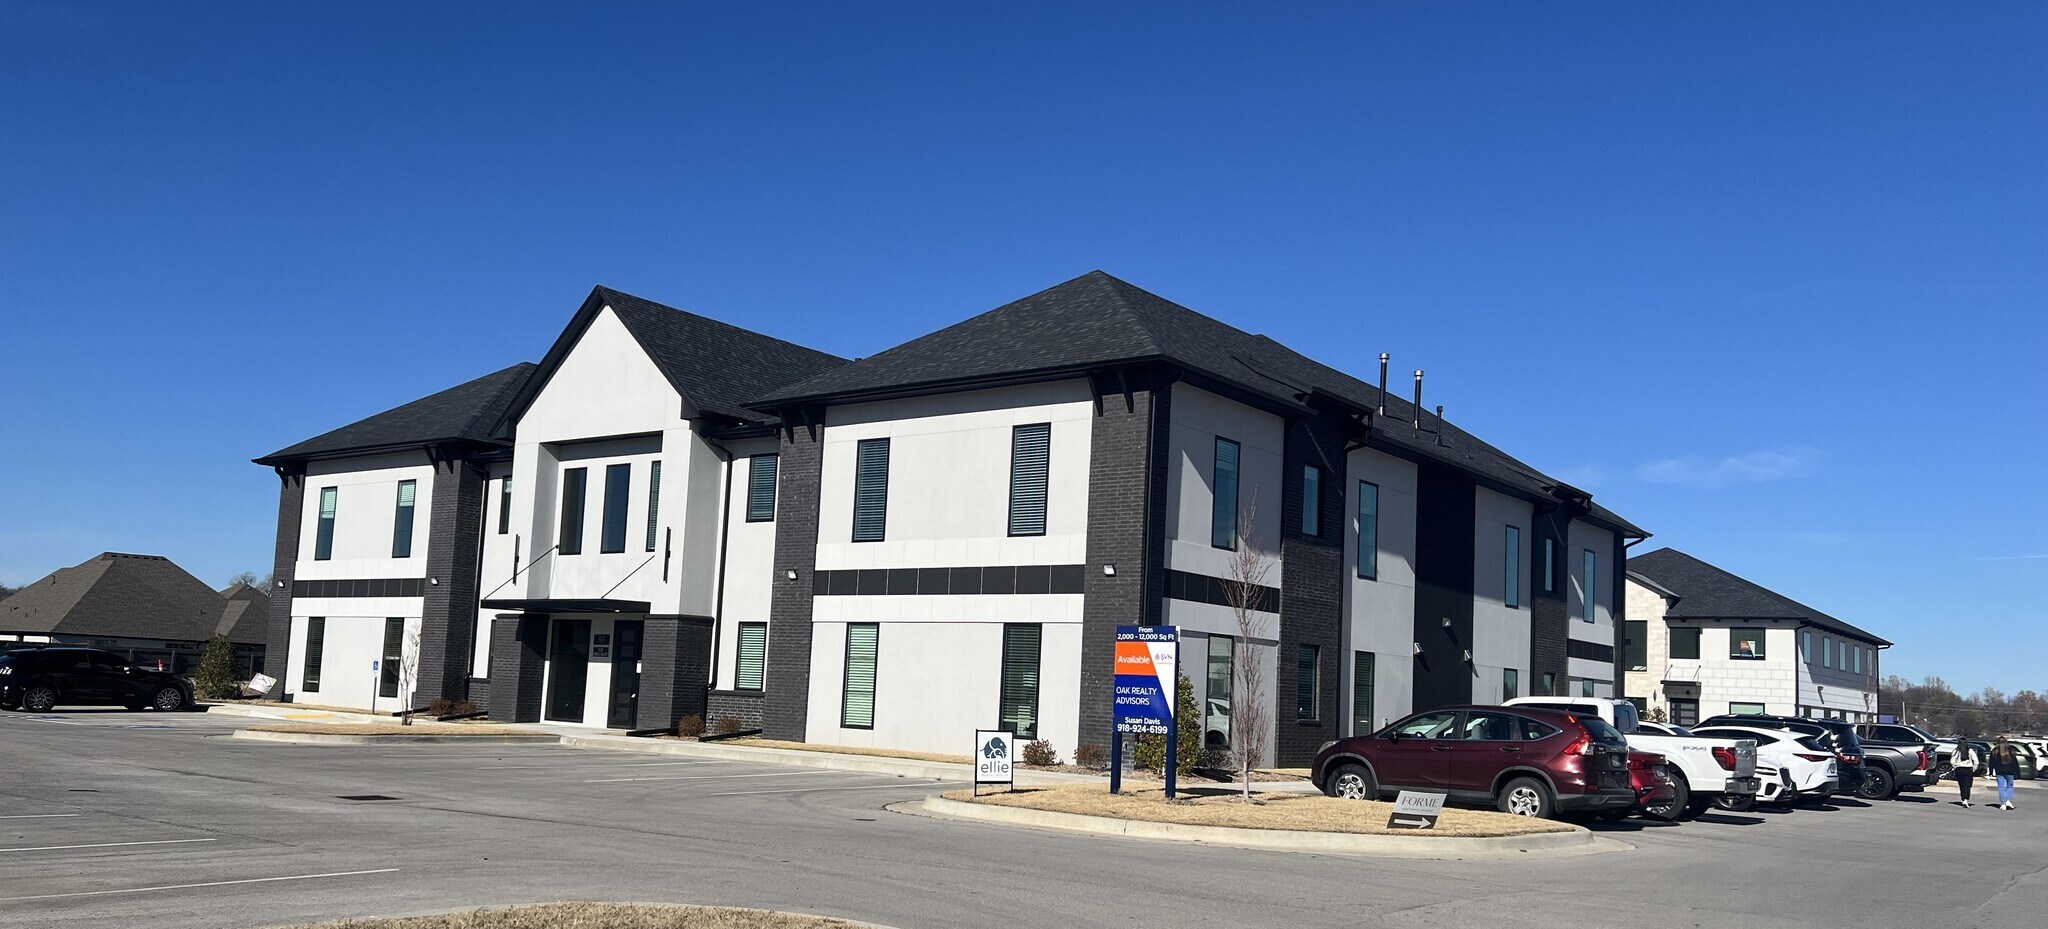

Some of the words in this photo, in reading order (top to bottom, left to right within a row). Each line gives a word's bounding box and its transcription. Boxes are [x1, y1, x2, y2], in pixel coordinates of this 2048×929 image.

[1118, 655, 1150, 664] Available
[1116, 686, 1130, 695] OAK
[1132, 687, 1157, 696] REALTY
[1116, 697, 1150, 706] ADVISORS
[1117, 724, 1168, 734] 918-924-6199
[981, 761, 1009, 773] ellie
[1402, 796, 1440, 807] FORME
